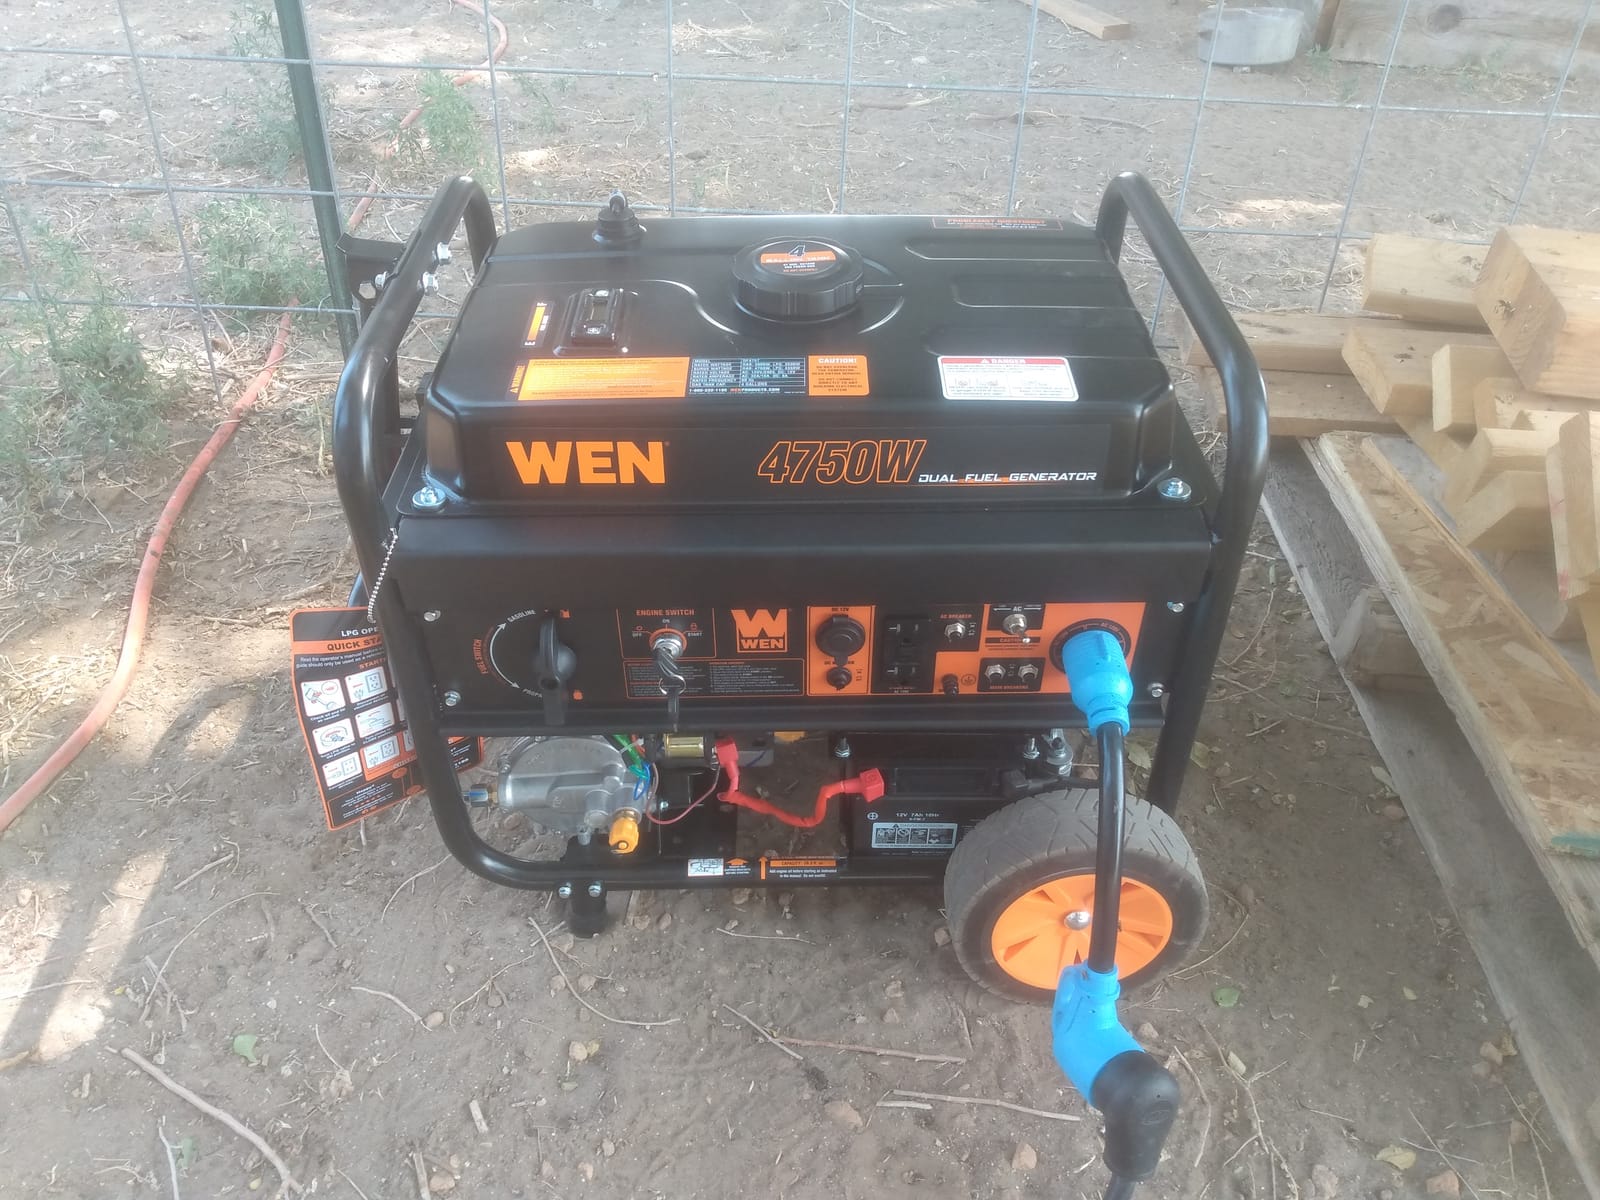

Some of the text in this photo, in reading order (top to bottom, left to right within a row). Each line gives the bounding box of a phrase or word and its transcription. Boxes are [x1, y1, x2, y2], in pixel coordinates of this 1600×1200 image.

[788, 244, 806, 257] 4
[506, 441, 666, 484] WEN
[757, 440, 1097, 484] 4750W DUAL FUEL GENERATOR
[507, 609, 536, 622] GASOLINE
[327, 642, 360, 651] QUICK
[741, 638, 784, 649] WEN
